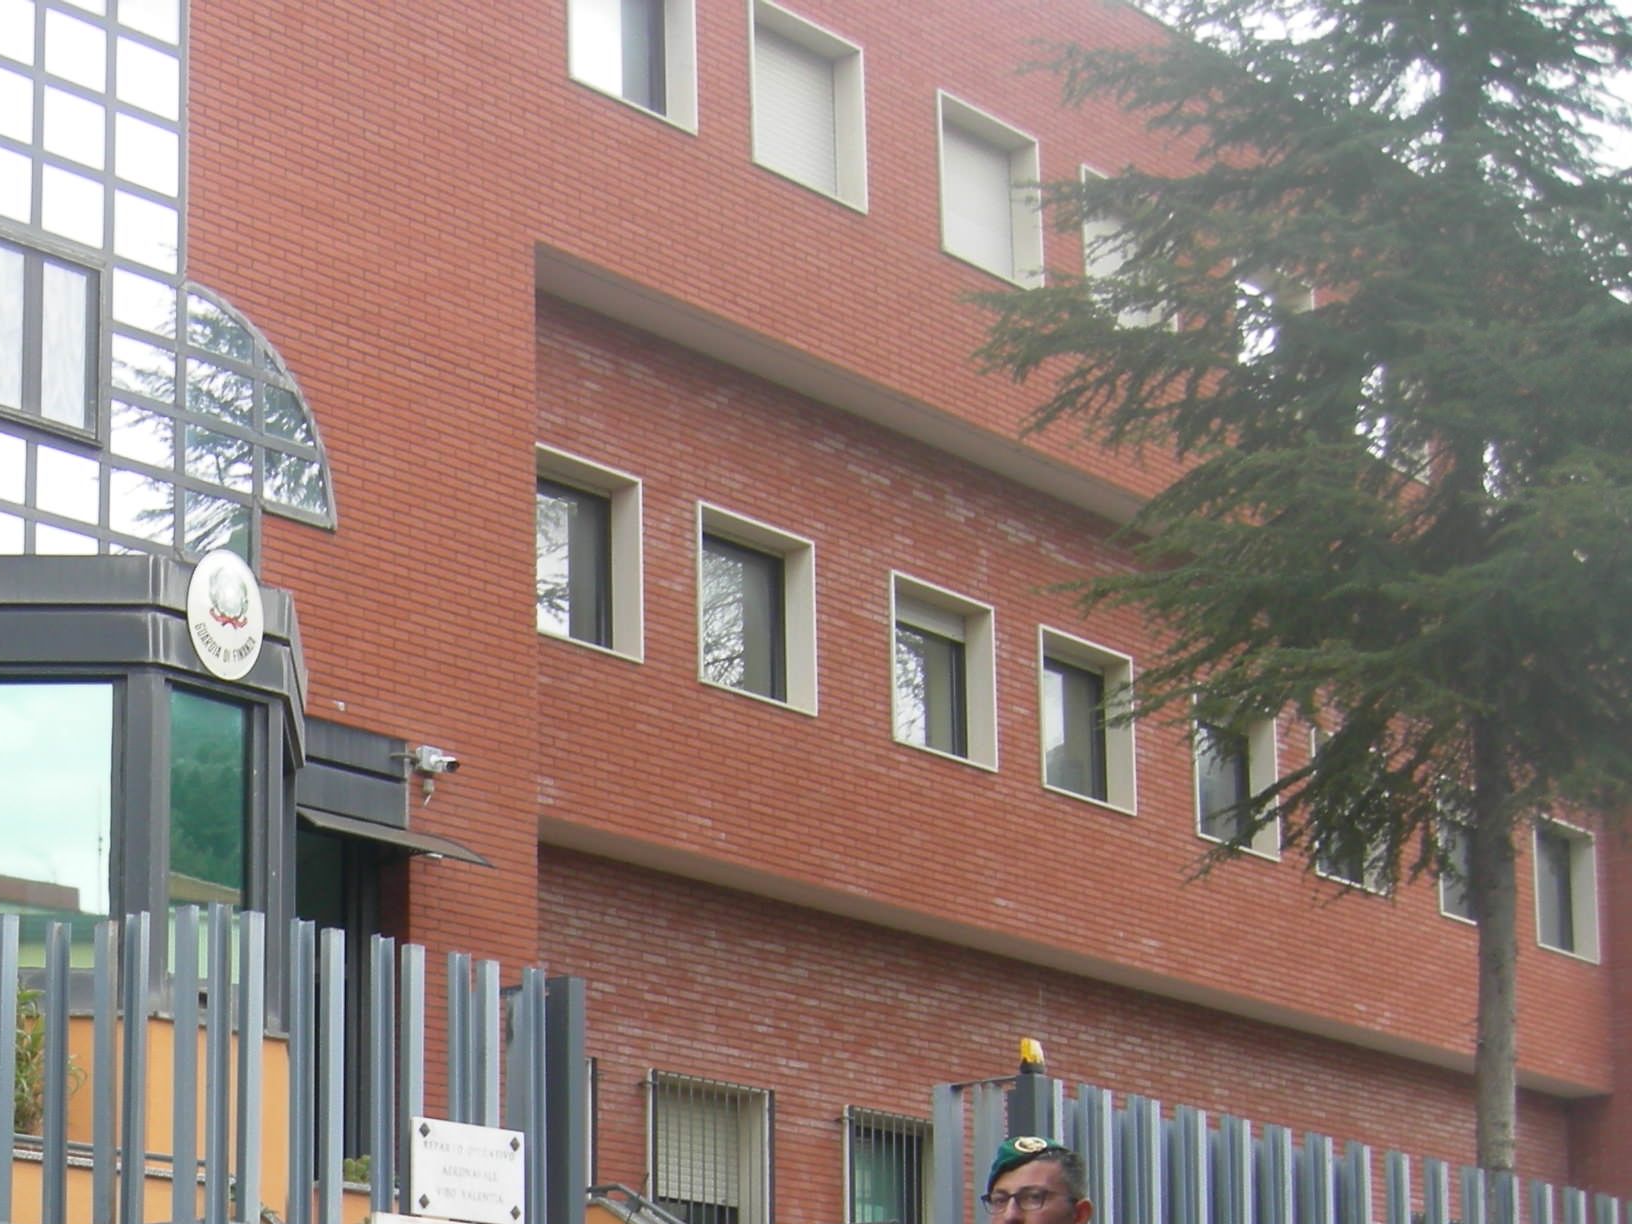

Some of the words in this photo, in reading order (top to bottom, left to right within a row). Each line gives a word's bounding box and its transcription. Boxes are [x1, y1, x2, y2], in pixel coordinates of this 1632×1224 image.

[194, 622, 221, 658] GUARDIA
[223, 648, 230, 663] DI
[233, 636, 256, 661] FINANZA
